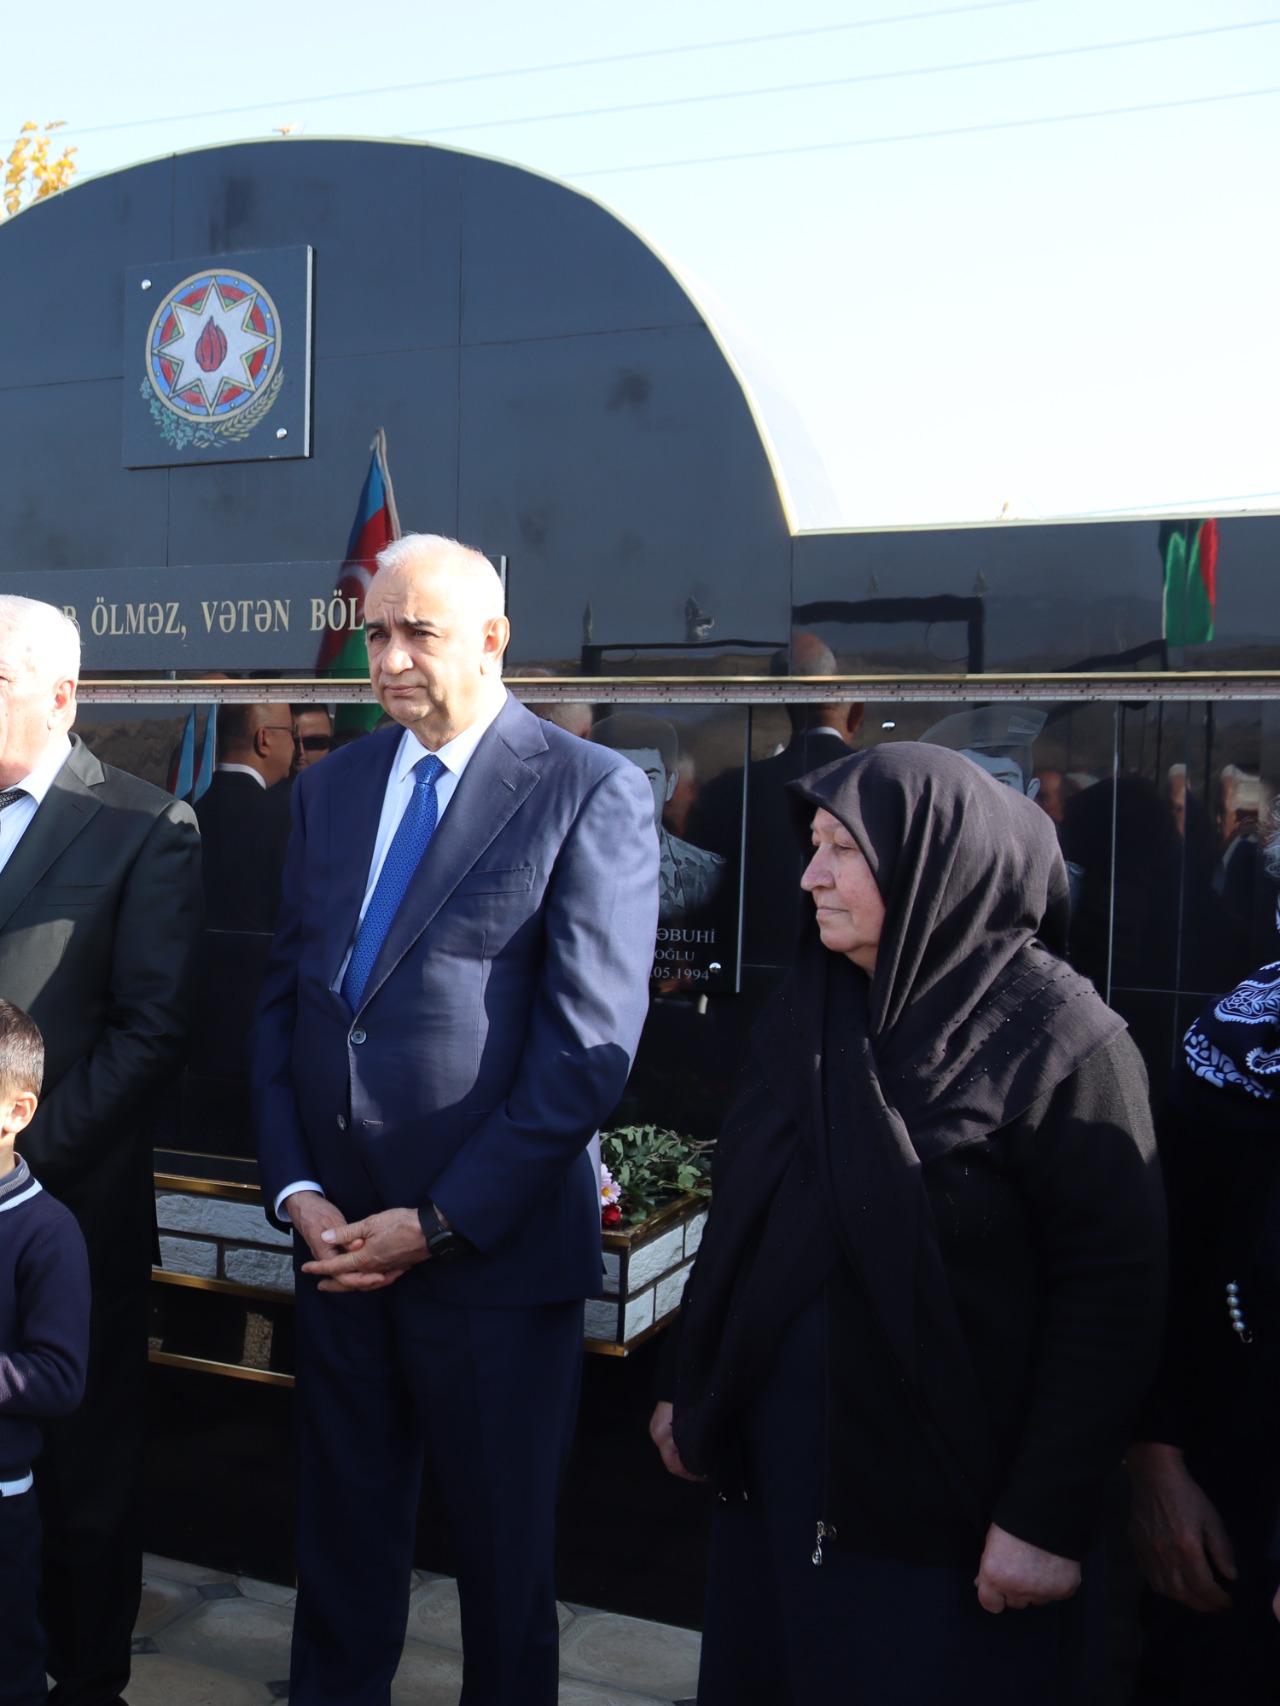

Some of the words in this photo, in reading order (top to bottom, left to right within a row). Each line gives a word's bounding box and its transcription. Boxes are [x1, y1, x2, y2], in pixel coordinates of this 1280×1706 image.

[91, 596, 187, 641] ÖLMƏZ,
[201, 599, 292, 634] VƏTƏN
[654, 947, 696, 962] OĞLU
